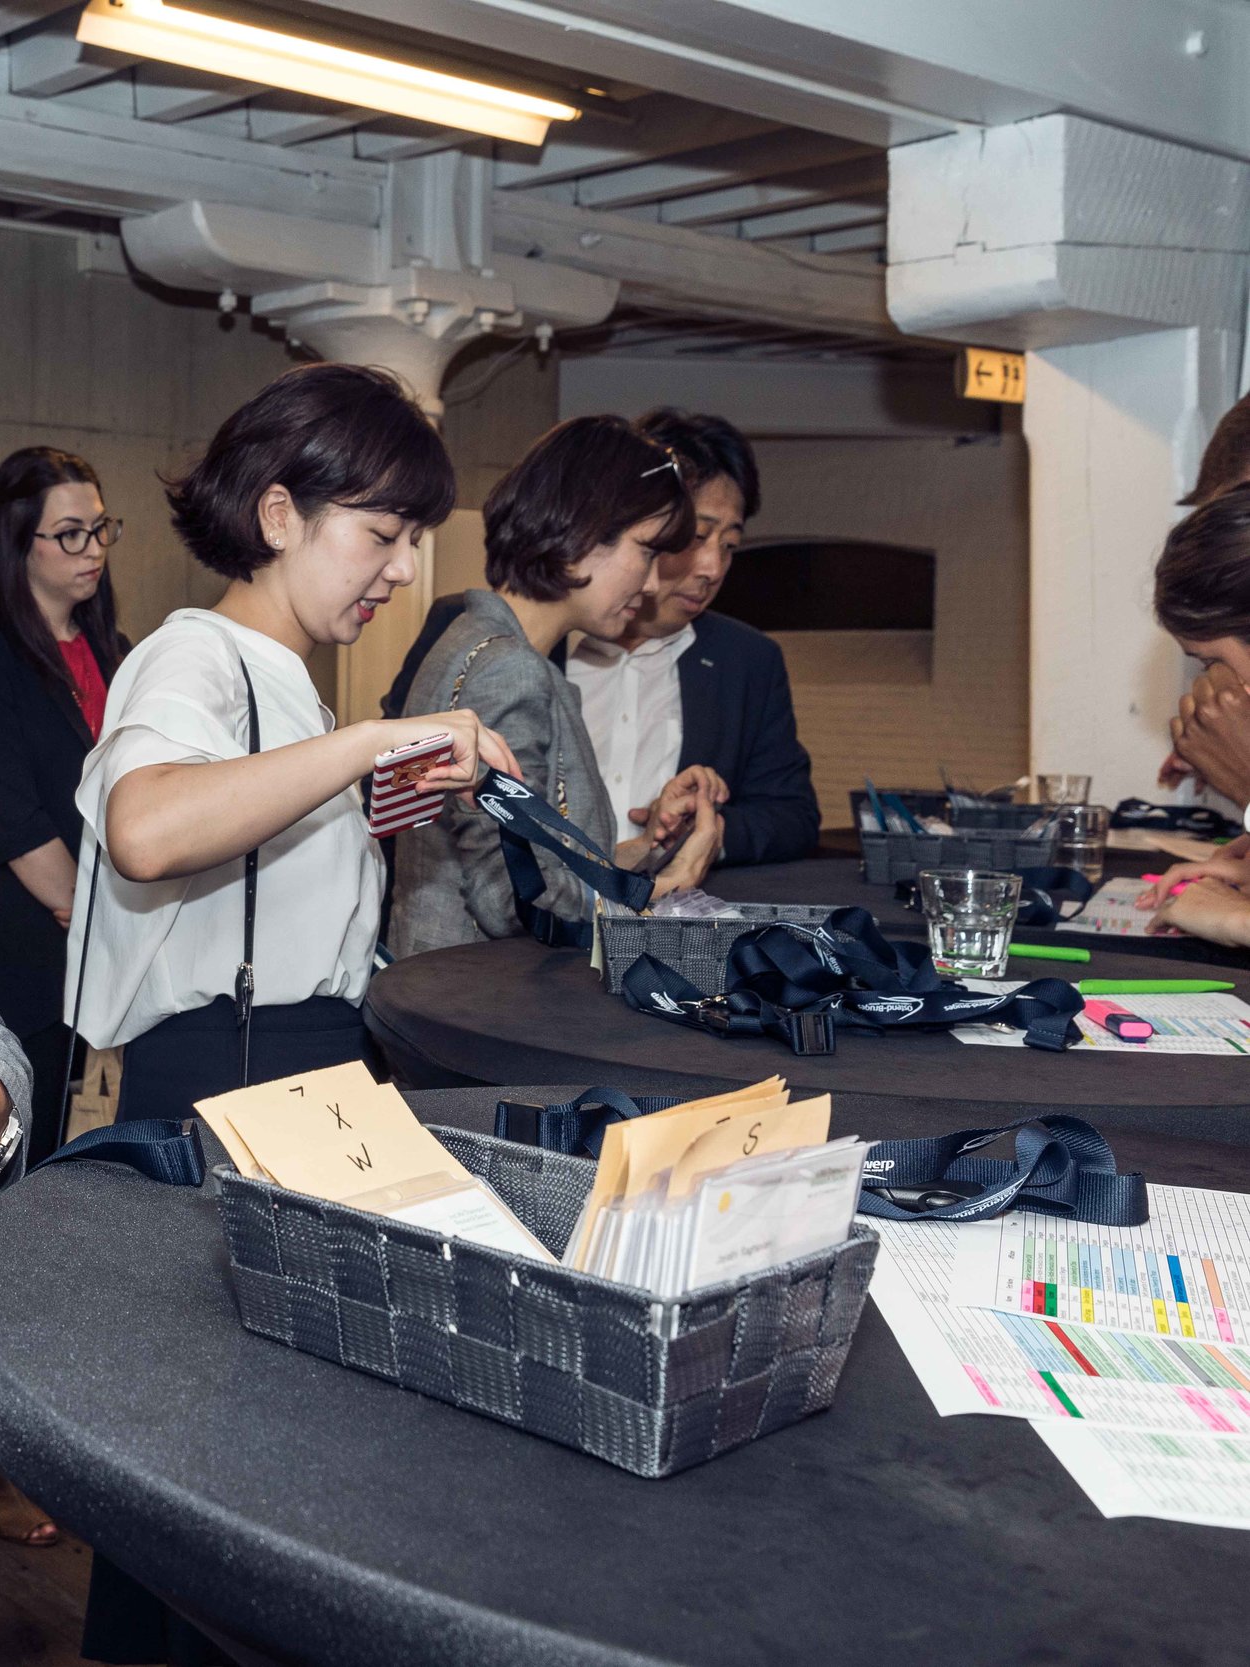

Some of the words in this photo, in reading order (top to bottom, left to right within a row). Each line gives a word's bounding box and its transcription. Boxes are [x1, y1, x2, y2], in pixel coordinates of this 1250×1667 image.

[326, 1102, 352, 1130] X
[742, 1121, 762, 1156] S
[346, 1142, 373, 1172] W
